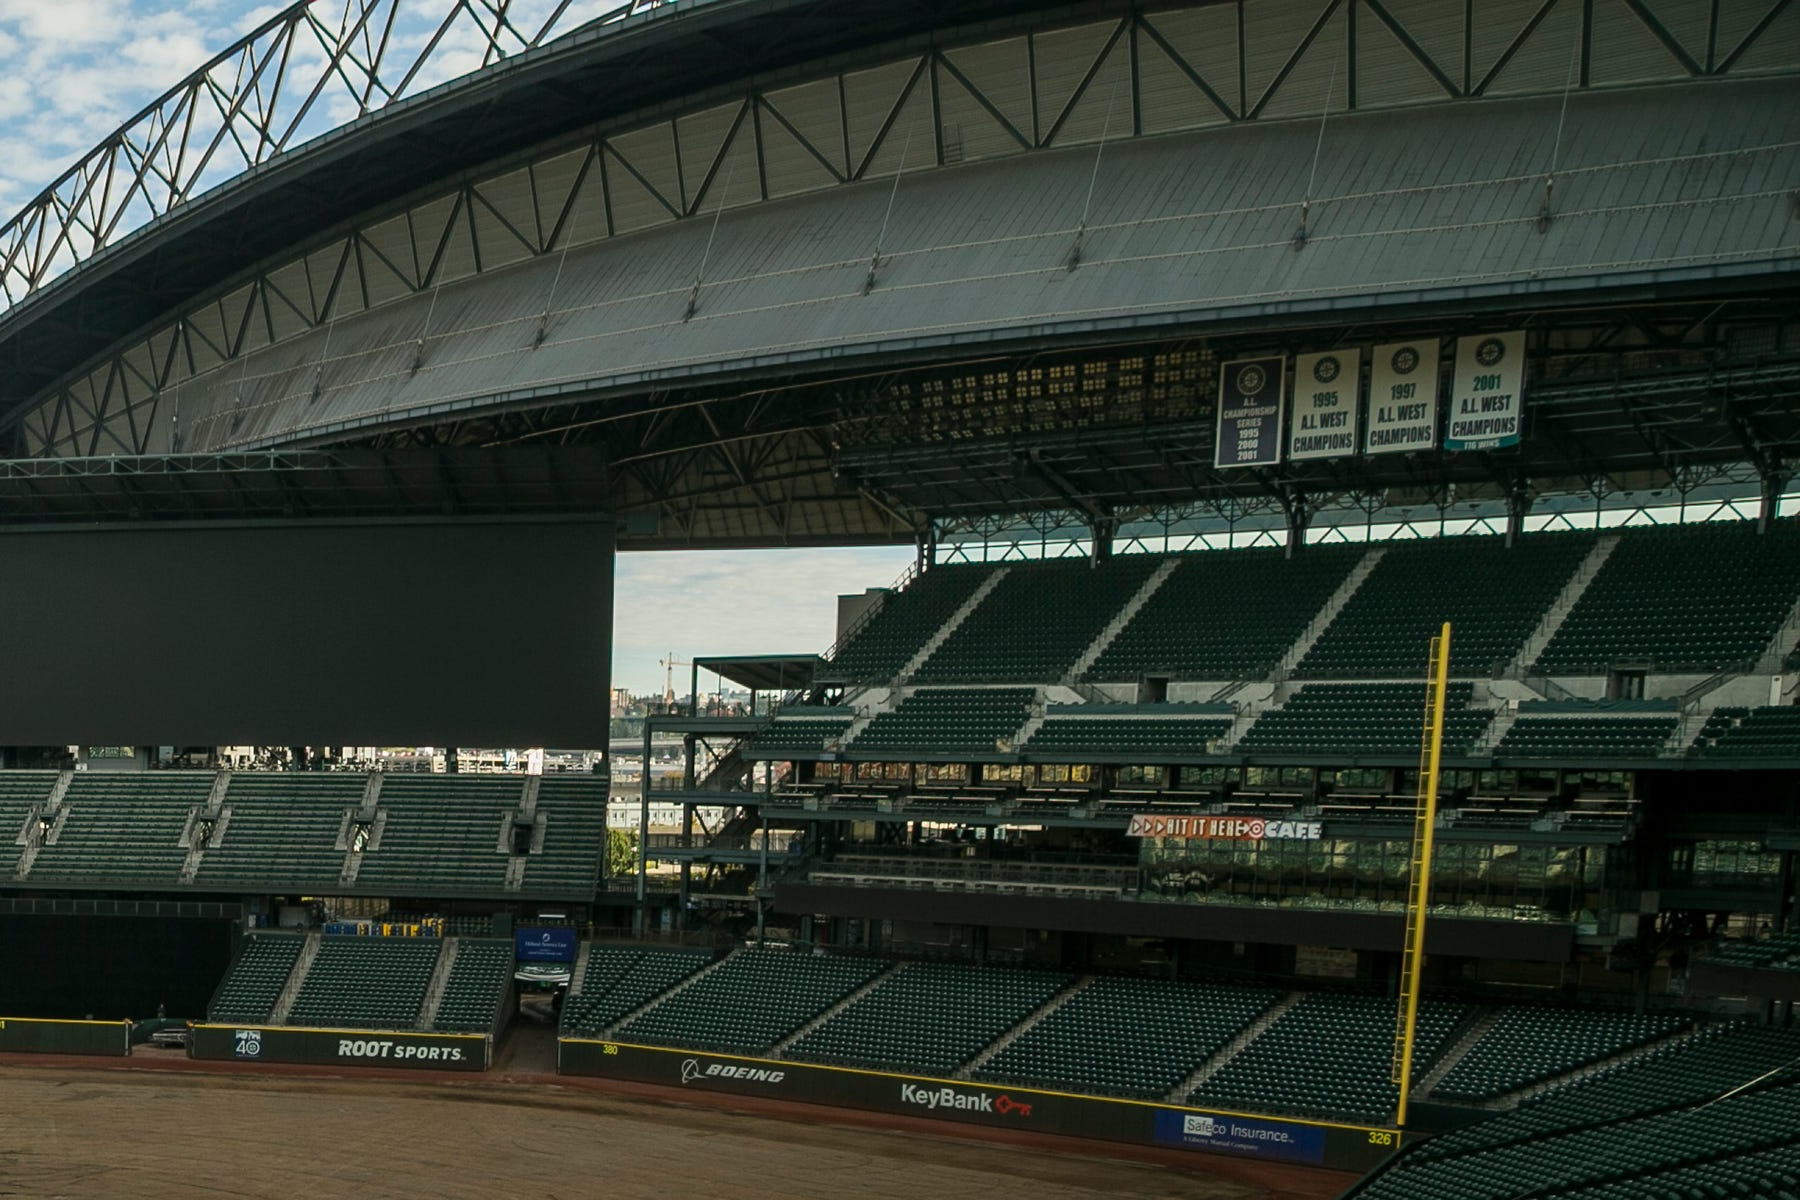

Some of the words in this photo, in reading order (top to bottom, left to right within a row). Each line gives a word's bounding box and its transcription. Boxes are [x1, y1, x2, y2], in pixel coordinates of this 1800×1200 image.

[1473, 374, 1501, 391] 2001
[1313, 391, 1338, 408] 1995
[1391, 383, 1416, 400] 1997
[1397, 403, 1428, 420] WEST
[1481, 395, 1512, 412] WEST
[1223, 406, 1277, 419] CHAMPIONSHIP
[1319, 411, 1349, 429] WEST
[1237, 418, 1262, 429] SERIES
[1452, 416, 1516, 437] CHAMPIONS
[1239, 428, 1259, 439] 1995
[1370, 425, 1432, 446] CHAMPIONS
[1237, 439, 1258, 450] 2000
[1293, 432, 1352, 453] CHAMPIONS
[1237, 450, 1257, 461] 2001
[1167, 818, 1188, 835] HIT
[1192, 819, 1206, 835] IT
[1210, 820, 1243, 836] HERE
[1265, 821, 1322, 839] CAFE
[338, 1039, 393, 1057] ROOT
[395, 1046, 462, 1061] SPORTS
[603, 1045, 618, 1055] 380
[705, 1064, 785, 1083] BOEING
[902, 1084, 993, 1112] KeyBank
[1187, 1118, 1226, 1135] Safeco
[1231, 1124, 1289, 1142] Insurance
[1368, 1132, 1391, 1145] 326
